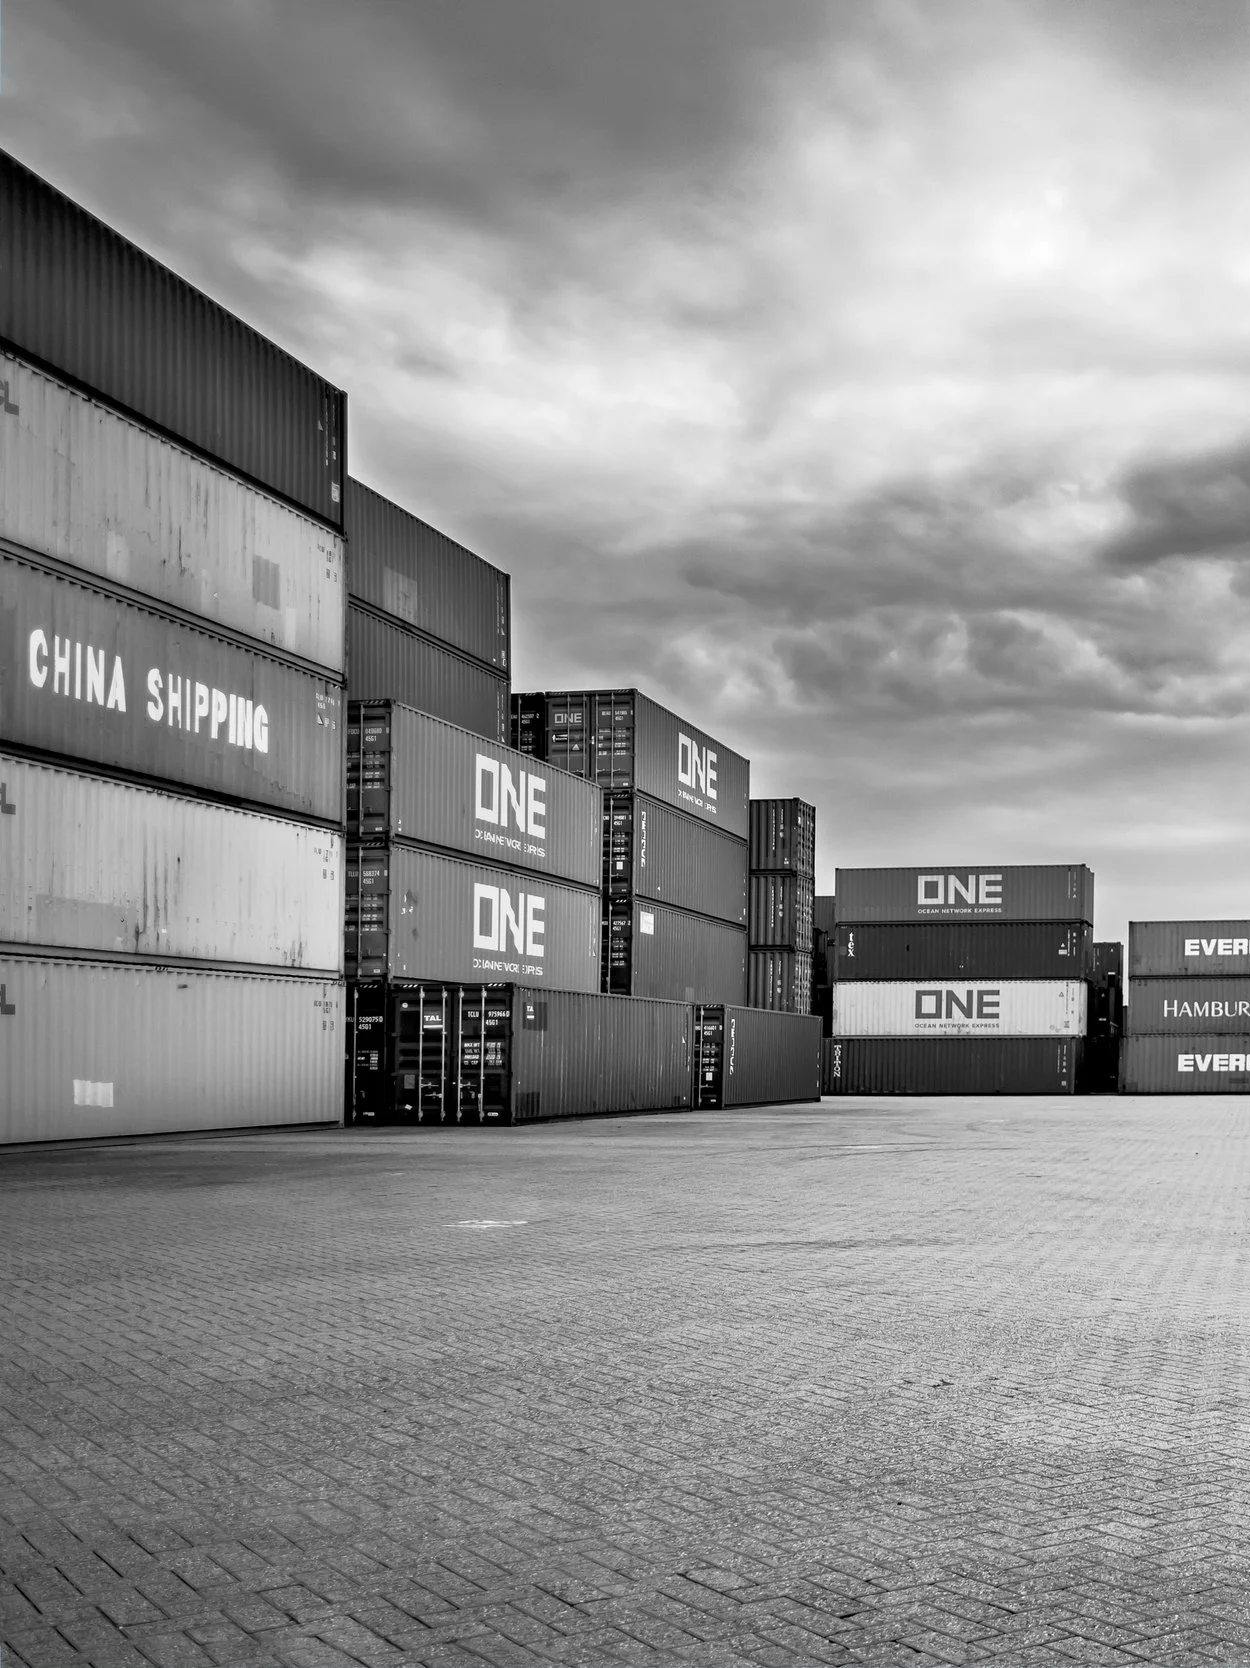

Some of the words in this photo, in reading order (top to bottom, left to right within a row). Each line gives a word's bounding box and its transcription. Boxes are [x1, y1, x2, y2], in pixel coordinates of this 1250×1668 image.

[30, 629, 126, 712] CHINA
[148, 669, 268, 753] SHIPPING
[554, 713, 582, 724] ONE
[476, 754, 546, 839] ONE
[678, 732, 717, 800] ONE
[474, 883, 545, 957] ONE
[918, 875, 1002, 904] ONE
[915, 990, 1000, 1019] ONE
